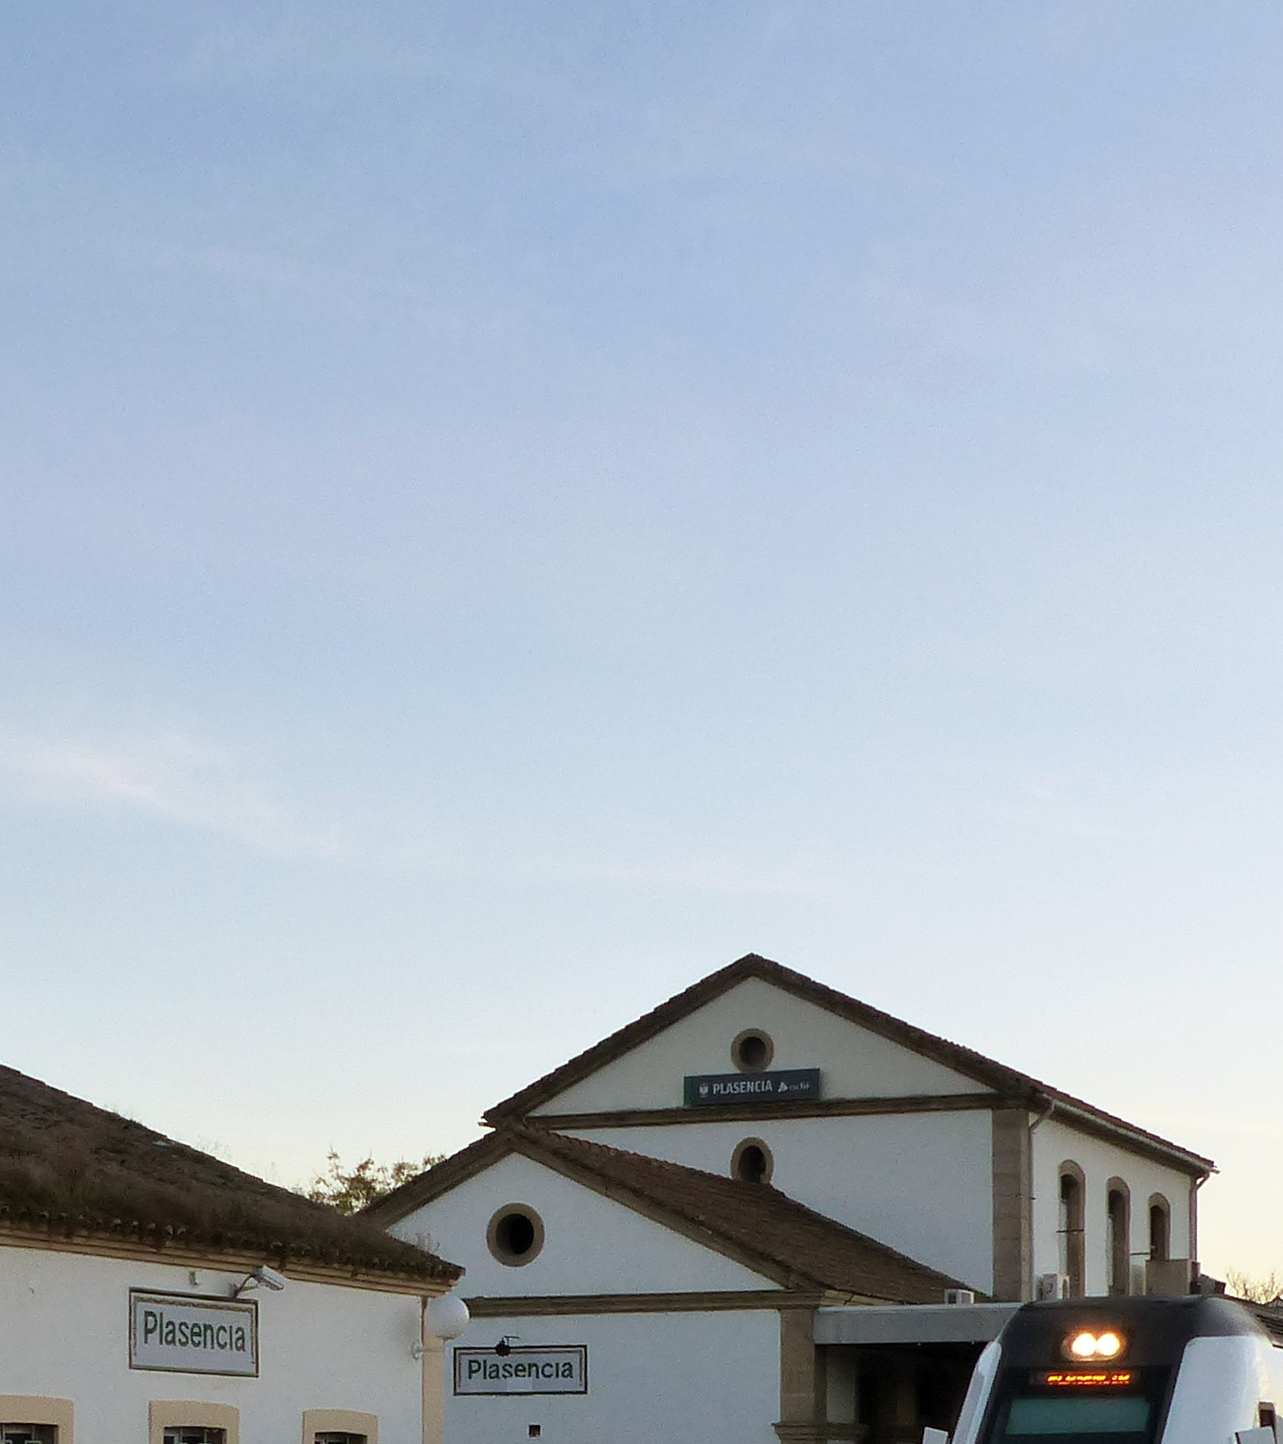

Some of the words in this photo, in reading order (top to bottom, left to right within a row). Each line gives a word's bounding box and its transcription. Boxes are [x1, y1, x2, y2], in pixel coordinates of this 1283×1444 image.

[713, 1080, 773, 1095] PLASENCIA
[144, 1310, 246, 1352] Plasencia
[467, 1359, 574, 1380] Plasencia
